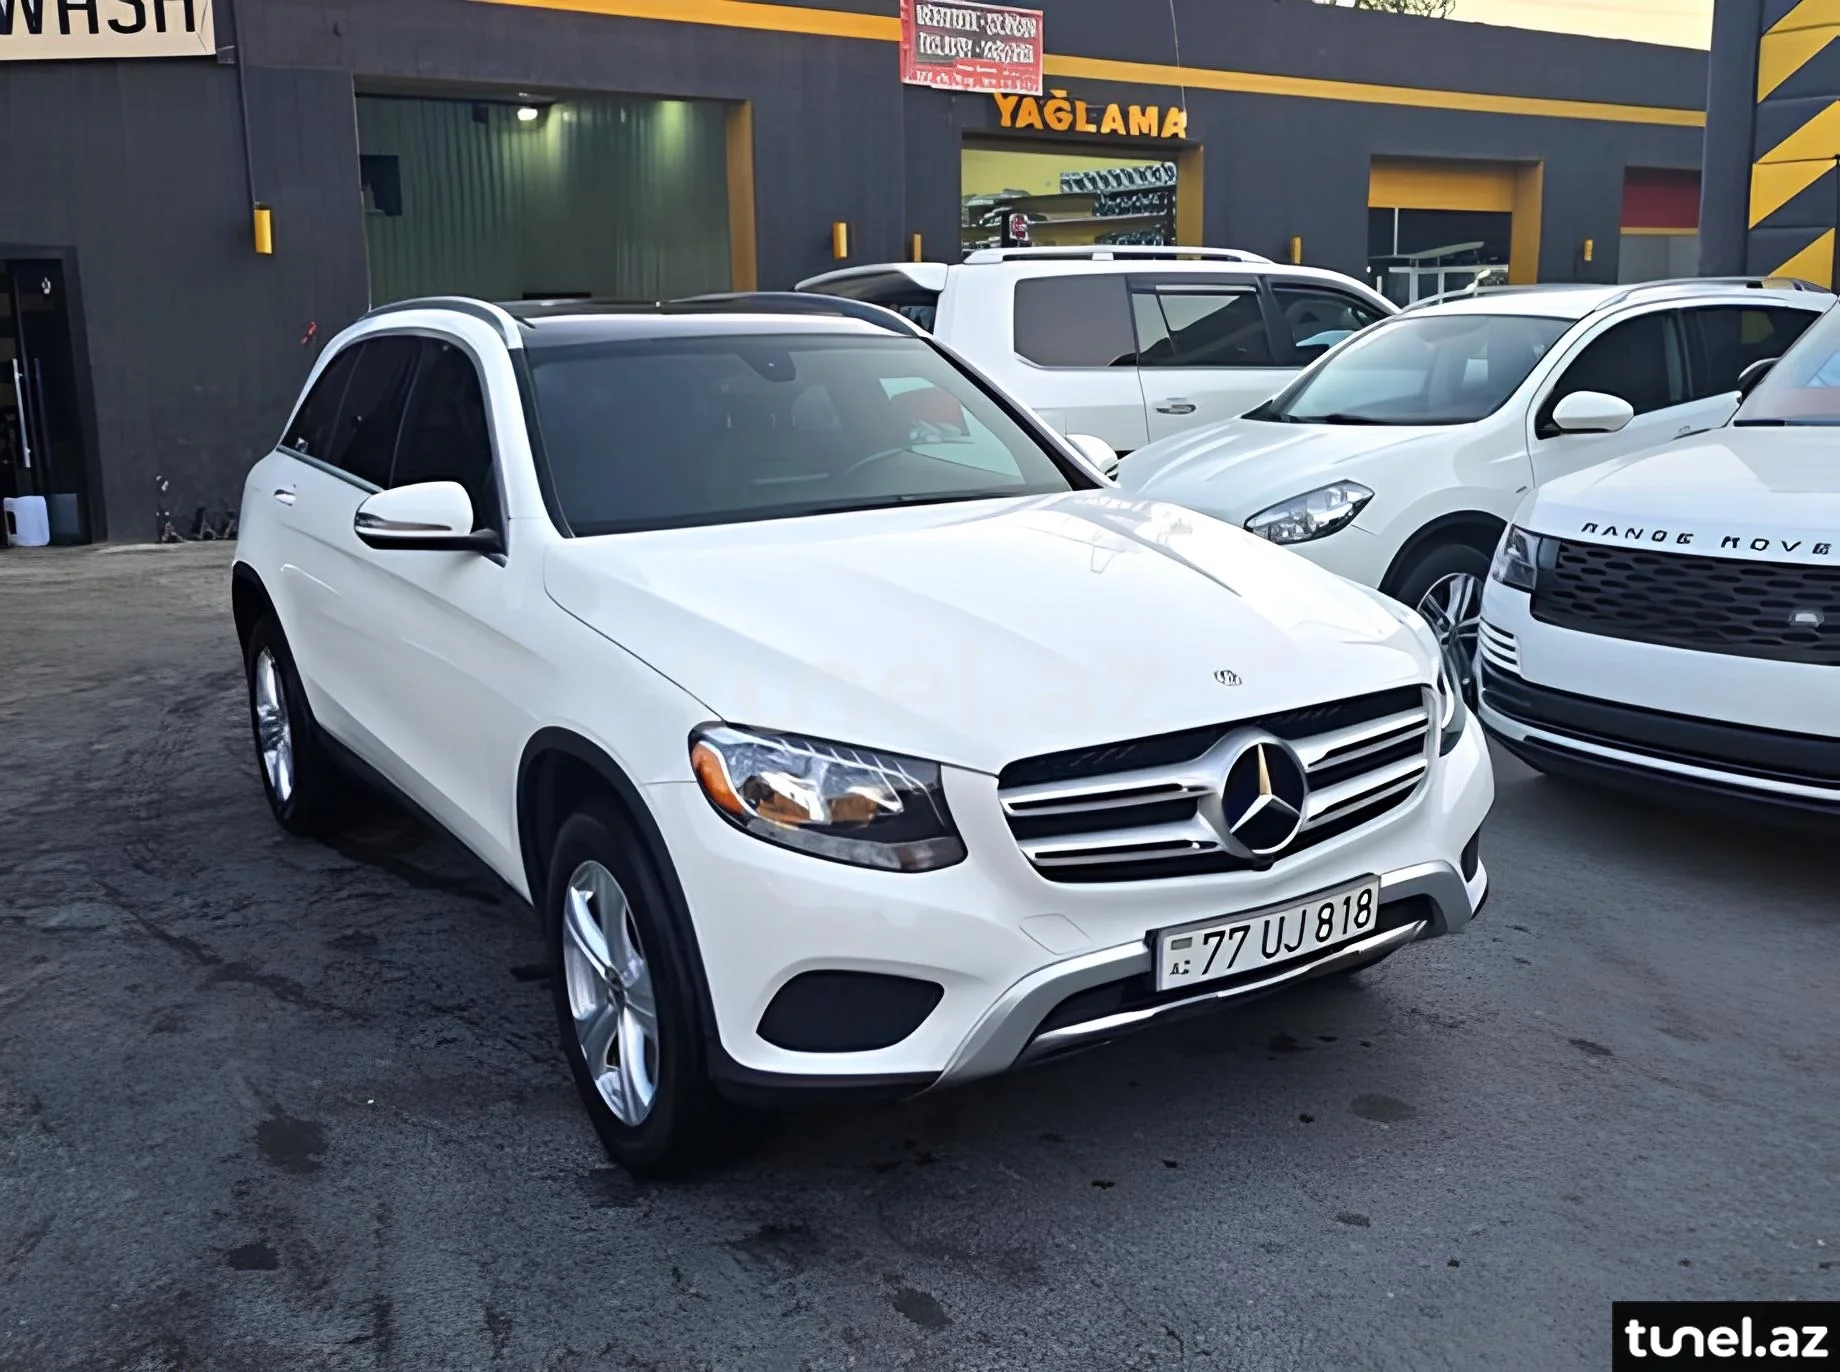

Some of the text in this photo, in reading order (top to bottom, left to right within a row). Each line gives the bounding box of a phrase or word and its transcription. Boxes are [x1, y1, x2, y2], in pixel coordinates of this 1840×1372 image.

[993, 89, 1188, 139] YAĞLAMA
[1201, 888, 1373, 976] 77 UJ 818
